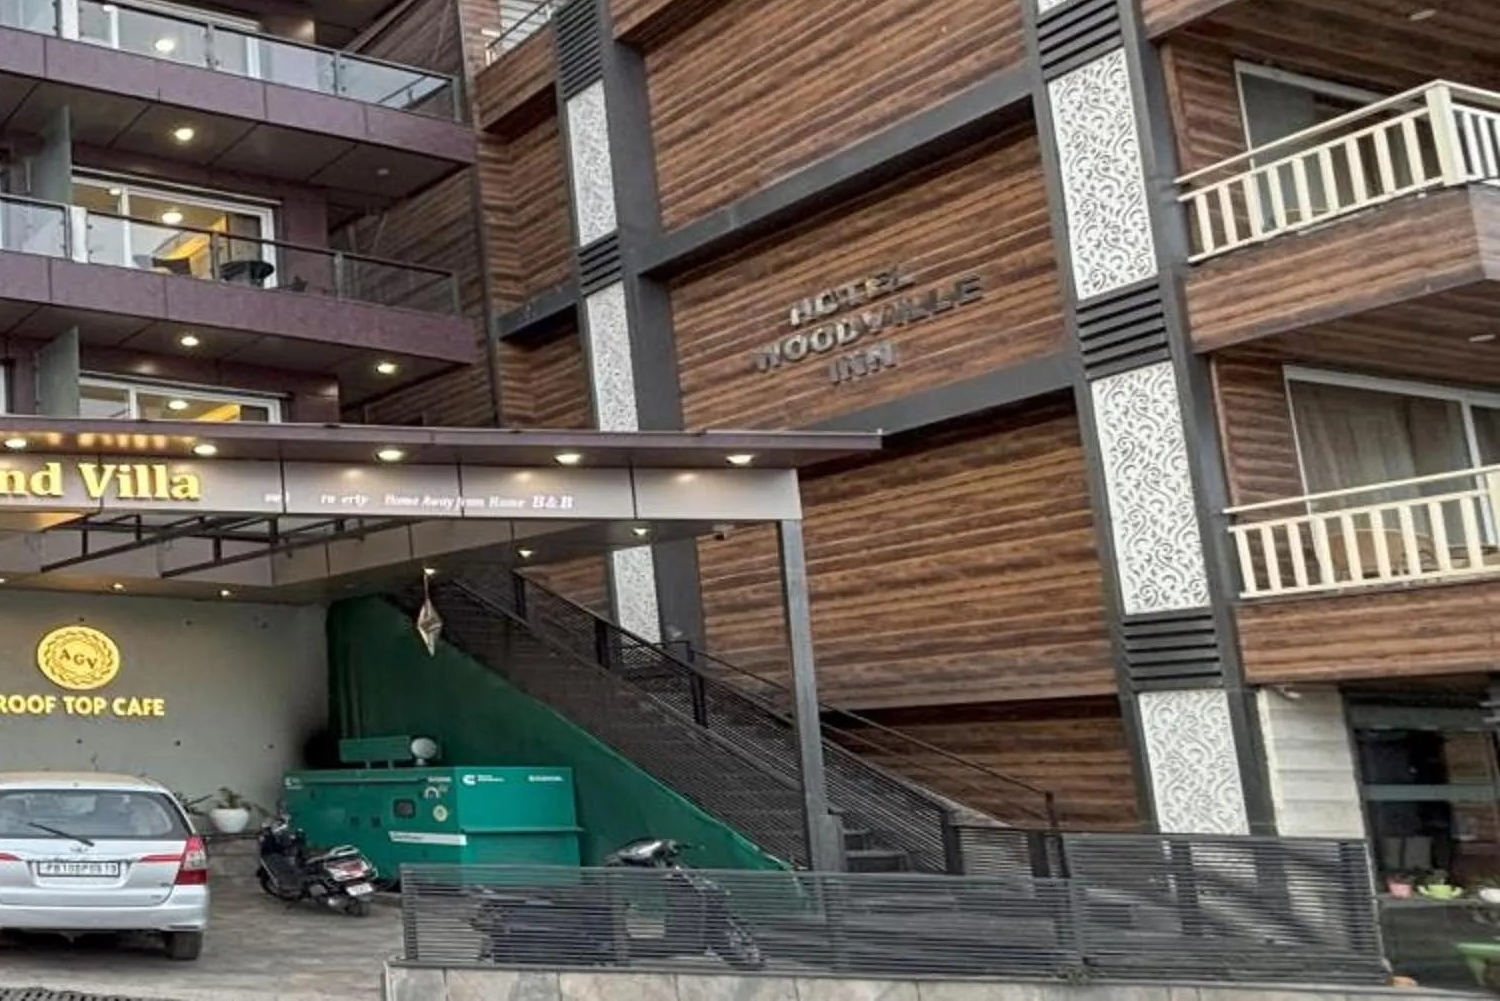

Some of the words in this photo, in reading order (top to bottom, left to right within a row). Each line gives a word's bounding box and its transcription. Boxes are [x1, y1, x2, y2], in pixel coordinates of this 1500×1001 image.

[790, 266, 916, 327] HOTEL
[752, 273, 984, 372] WOODVILLE
[828, 340, 896, 384] INN
[77, 462, 201, 500] Villa
[62, 694, 108, 716] TOP
[111, 696, 166, 717] CAFE
